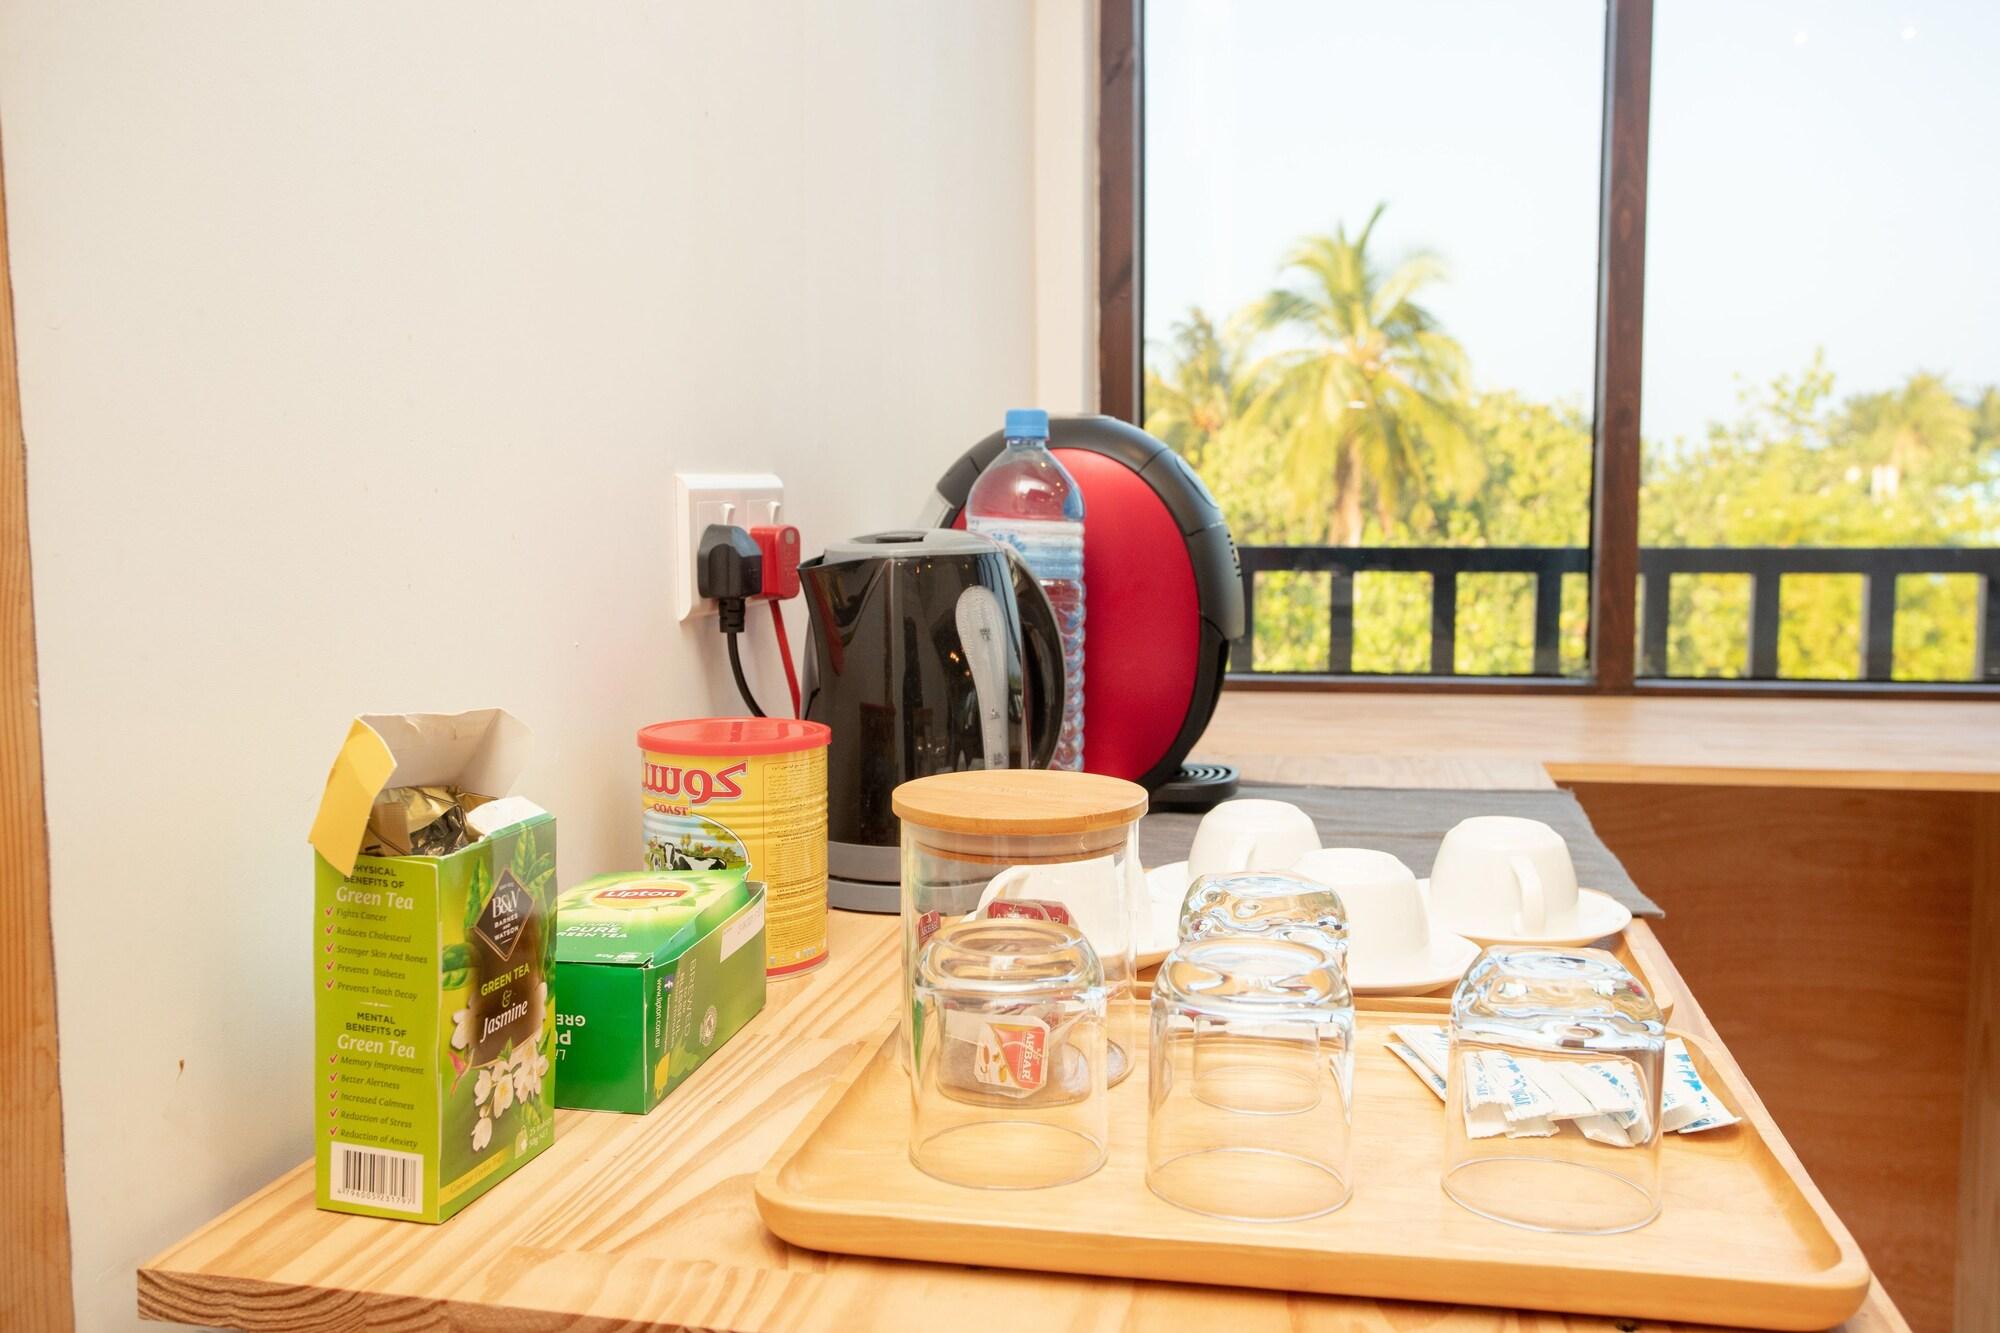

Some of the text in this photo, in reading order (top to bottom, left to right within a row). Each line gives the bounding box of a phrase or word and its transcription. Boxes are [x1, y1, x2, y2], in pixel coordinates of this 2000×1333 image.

[654, 803, 689, 816] COAST
[344, 875, 404, 888] BENEFITS OF
[336, 886, 414, 910] Green Tea
[605, 890, 678, 898] Lipton
[336, 908, 388, 922] Fights Cancer
[494, 913, 518, 928] BARNES
[336, 926, 412, 943] Reduces Cholesterol
[494, 925, 520, 940] WATSON
[336, 944, 428, 964] Stronger Skin And Bones
[337, 964, 406, 980] Prevents Diabetes
[481, 962, 530, 996] GREEN TEA
[337, 982, 418, 1001] Prevents Tooth Decay
[502, 990, 512, 1008] &
[684, 958, 696, 1036] BREWED
[356, 1012, 396, 1024] MENTAL
[556, 1014, 586, 1027] GRE
[654, 976, 662, 1048] www.lipton.com.au
[346, 1022, 407, 1038] BENEFITS OF
[480, 1000, 528, 1044] Jasmine
[338, 1033, 416, 1059] Green Tea
[341, 1056, 424, 1075] Memory Improvement
[341, 1074, 400, 1090] Better Alertness
[341, 1092, 415, 1110] Increased Calmness
[340, 1110, 412, 1128] Reduction of Stress
[340, 1129, 418, 1150] Reduction of Anxiety
